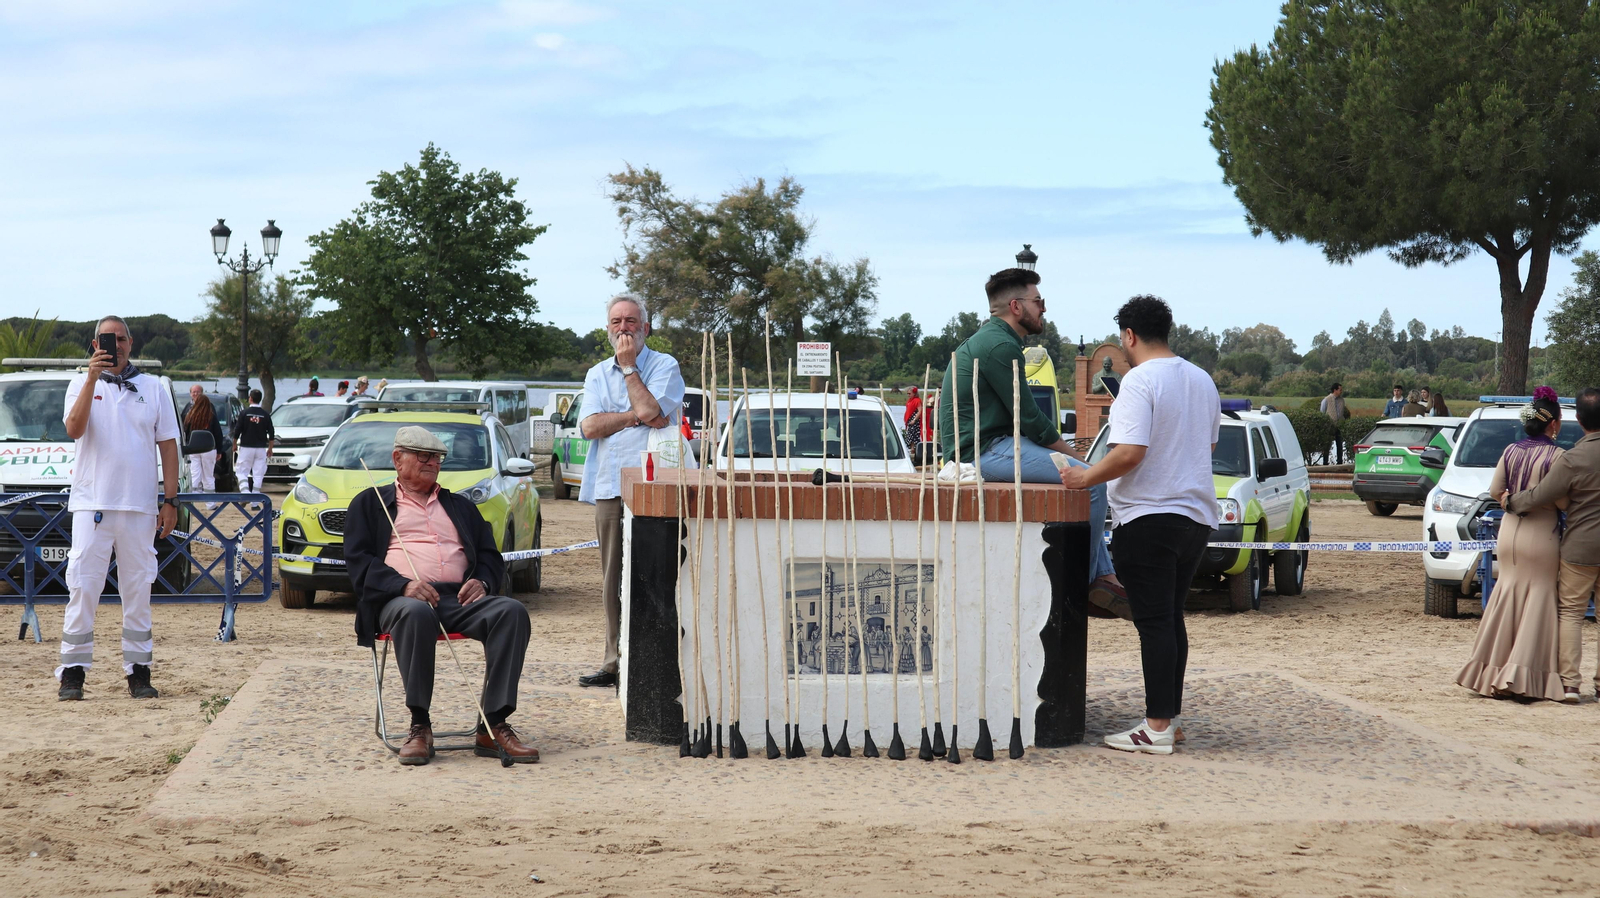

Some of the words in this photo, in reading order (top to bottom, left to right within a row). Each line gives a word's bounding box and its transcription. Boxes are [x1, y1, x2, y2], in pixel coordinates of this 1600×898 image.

[11, 455, 75, 465] BUJ
[301, 507, 318, 520] T-3
[1378, 543, 1400, 551] LOCAL
[1401, 543, 1428, 551] POLICIA
[1459, 542, 1480, 550] LOCAL
